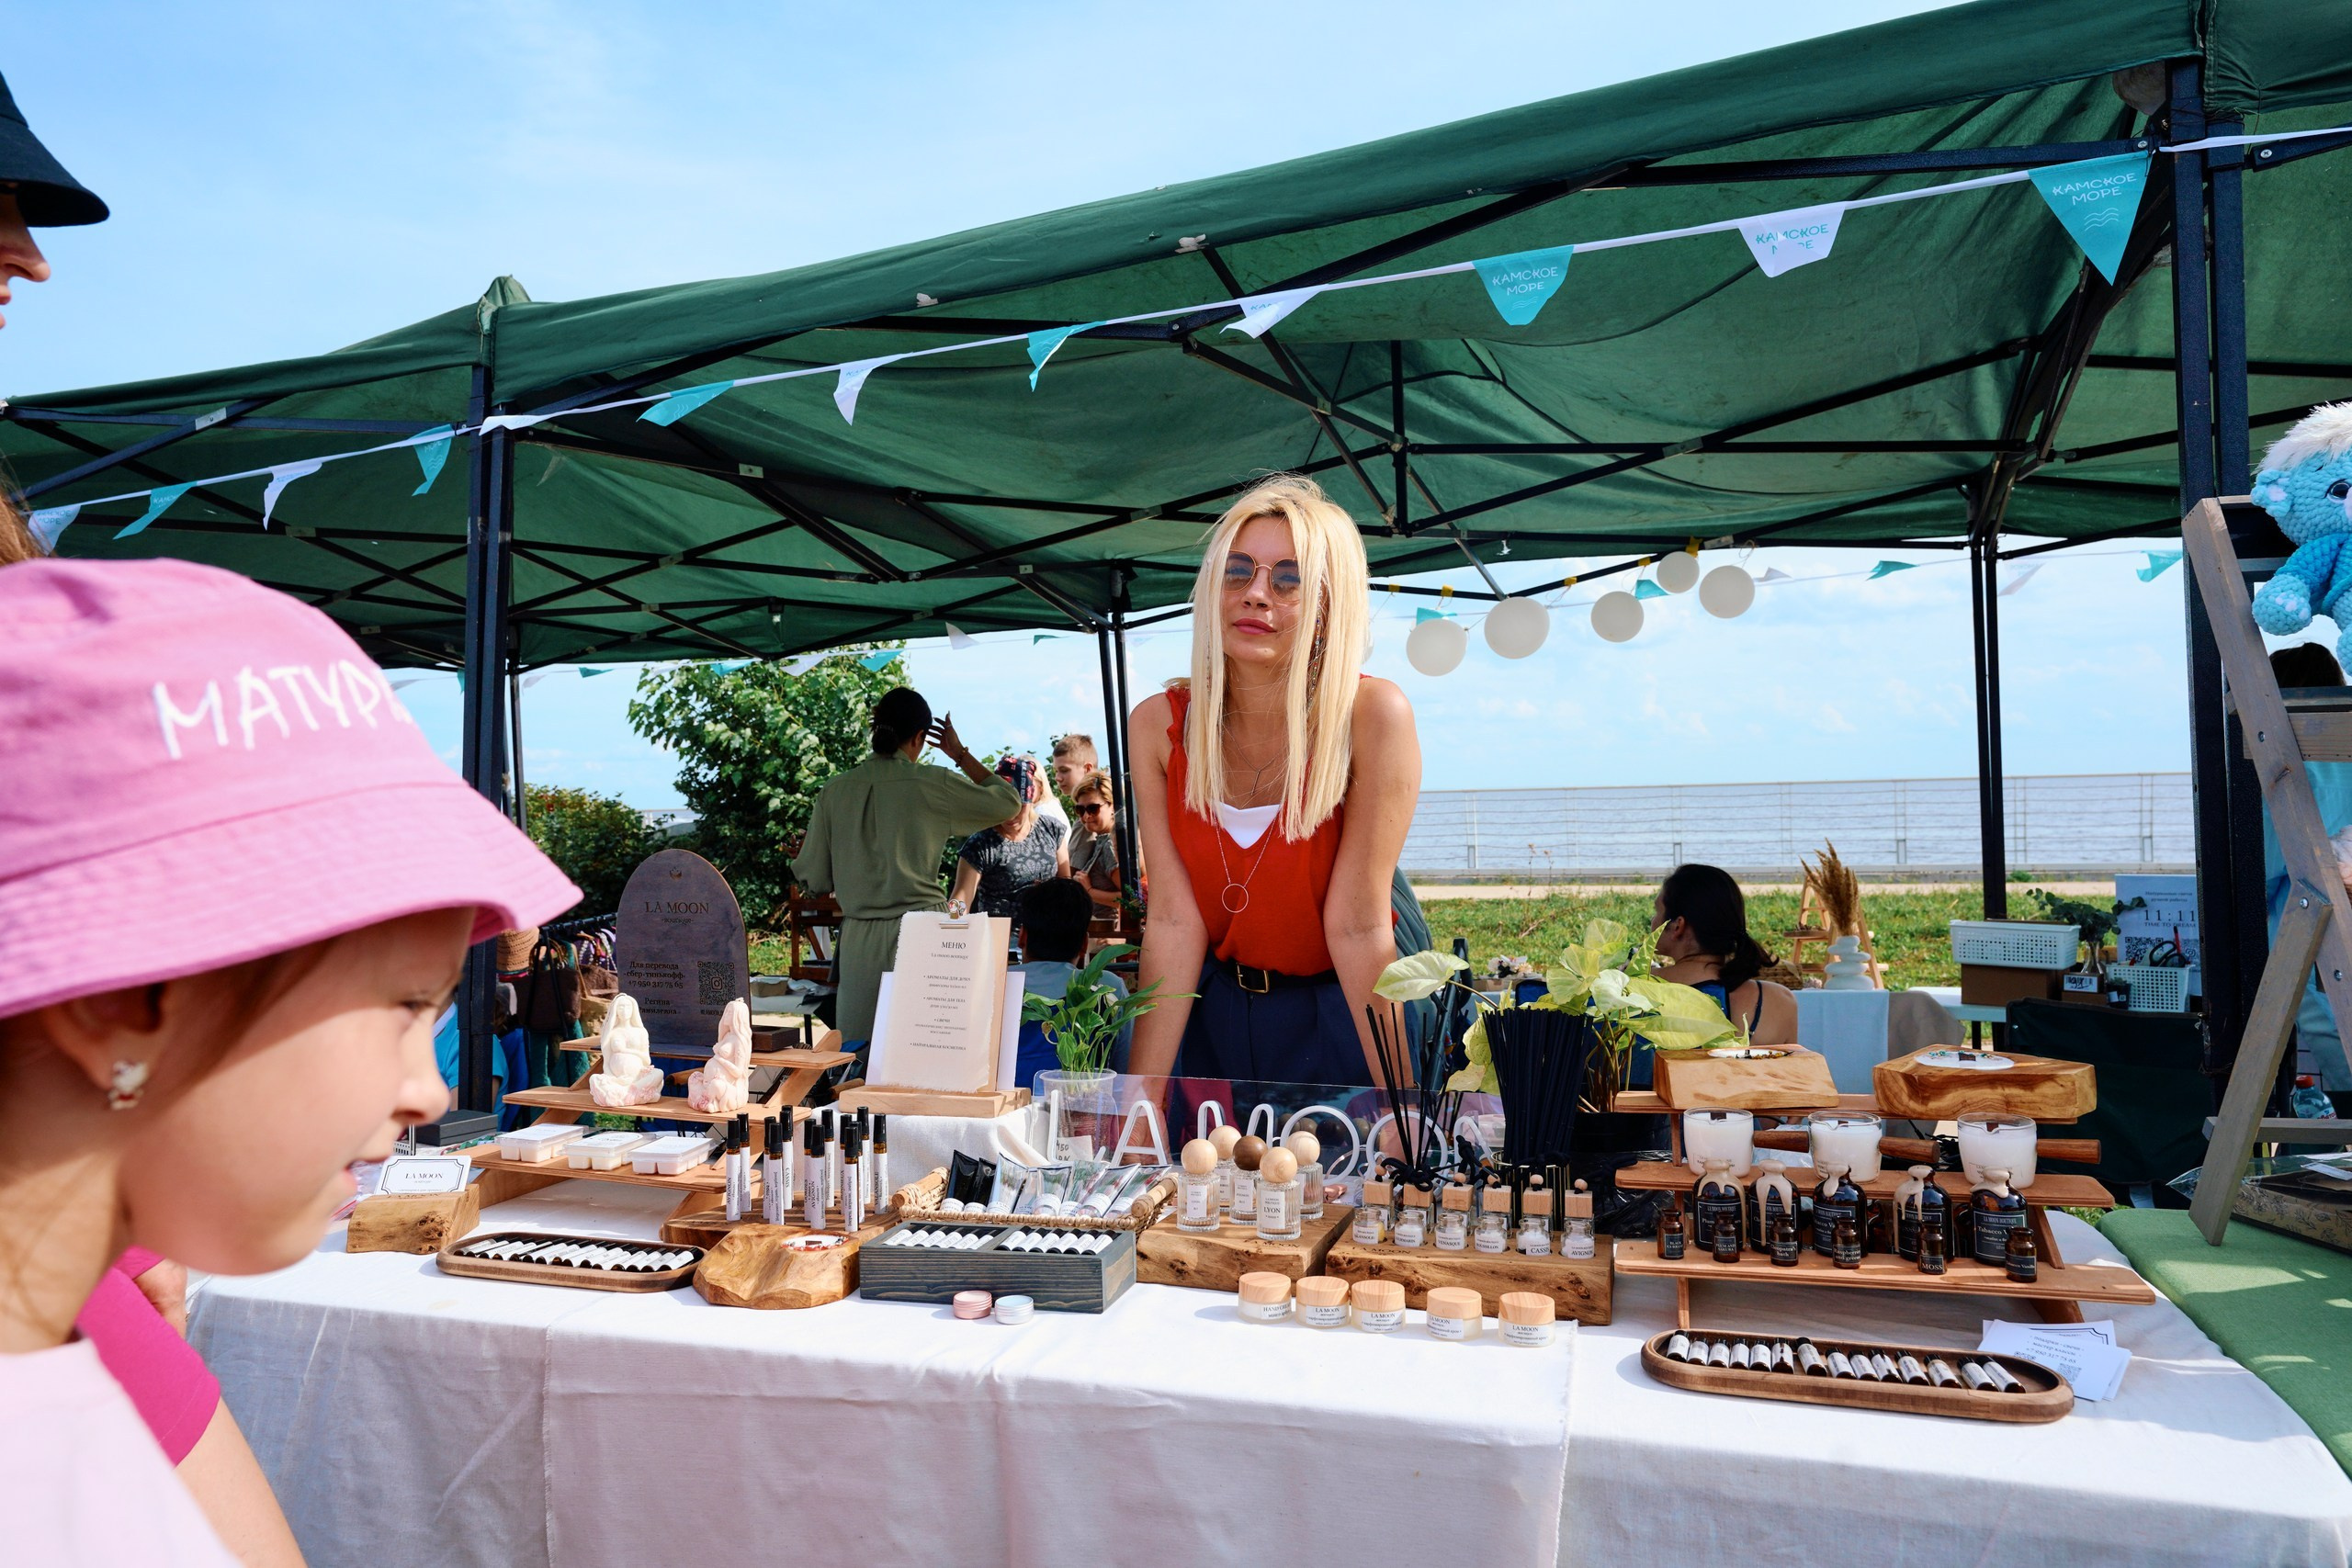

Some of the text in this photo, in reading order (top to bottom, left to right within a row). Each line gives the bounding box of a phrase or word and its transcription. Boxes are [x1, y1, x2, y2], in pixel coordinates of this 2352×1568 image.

[2052, 173, 2137, 196] КАМСКОЕ
[2072, 186, 2122, 205] МОРЕ
[1492, 266, 1558, 286] КАМСКОЕ
[1507, 282, 1544, 296] МОРЕ
[645, 902, 709, 914] LA MOON
[644, 998, 670, 1006] Регина
